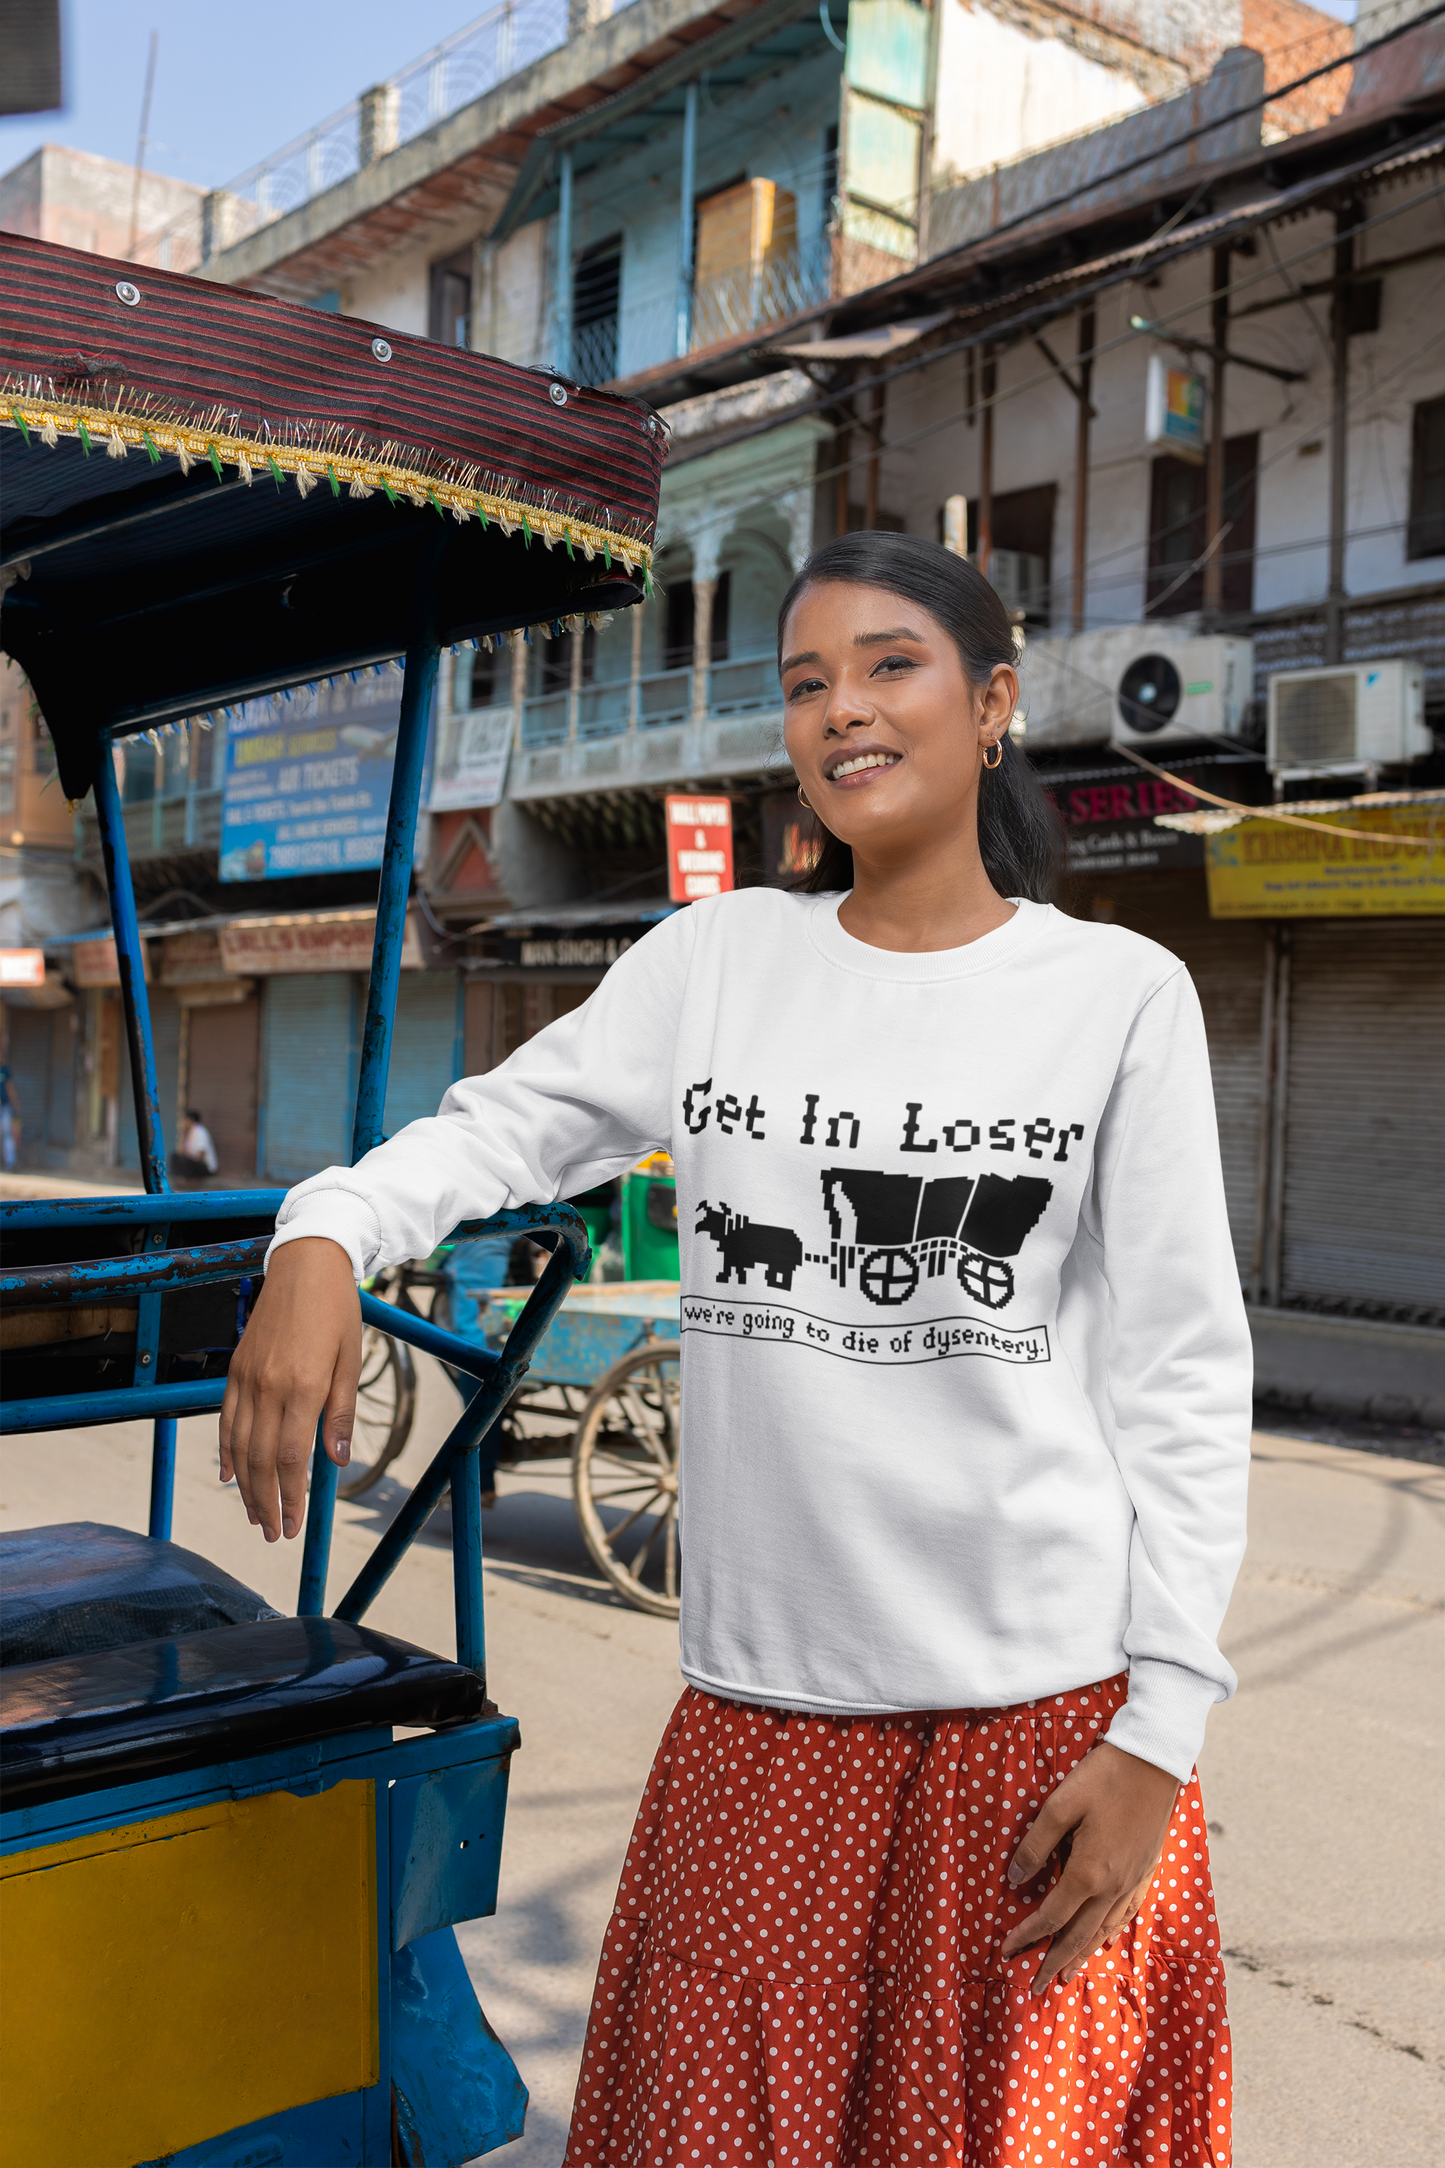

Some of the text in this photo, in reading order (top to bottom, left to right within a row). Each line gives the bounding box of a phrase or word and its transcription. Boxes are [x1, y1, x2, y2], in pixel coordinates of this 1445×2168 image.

[1069, 776, 1199, 825] SERIES
[694, 829, 707, 850] &
[556, 937, 604, 966] SINGH
[683, 1077, 1084, 1162] Get In Loser
[684, 1305, 1044, 1361] we're going to die of dysentery.
